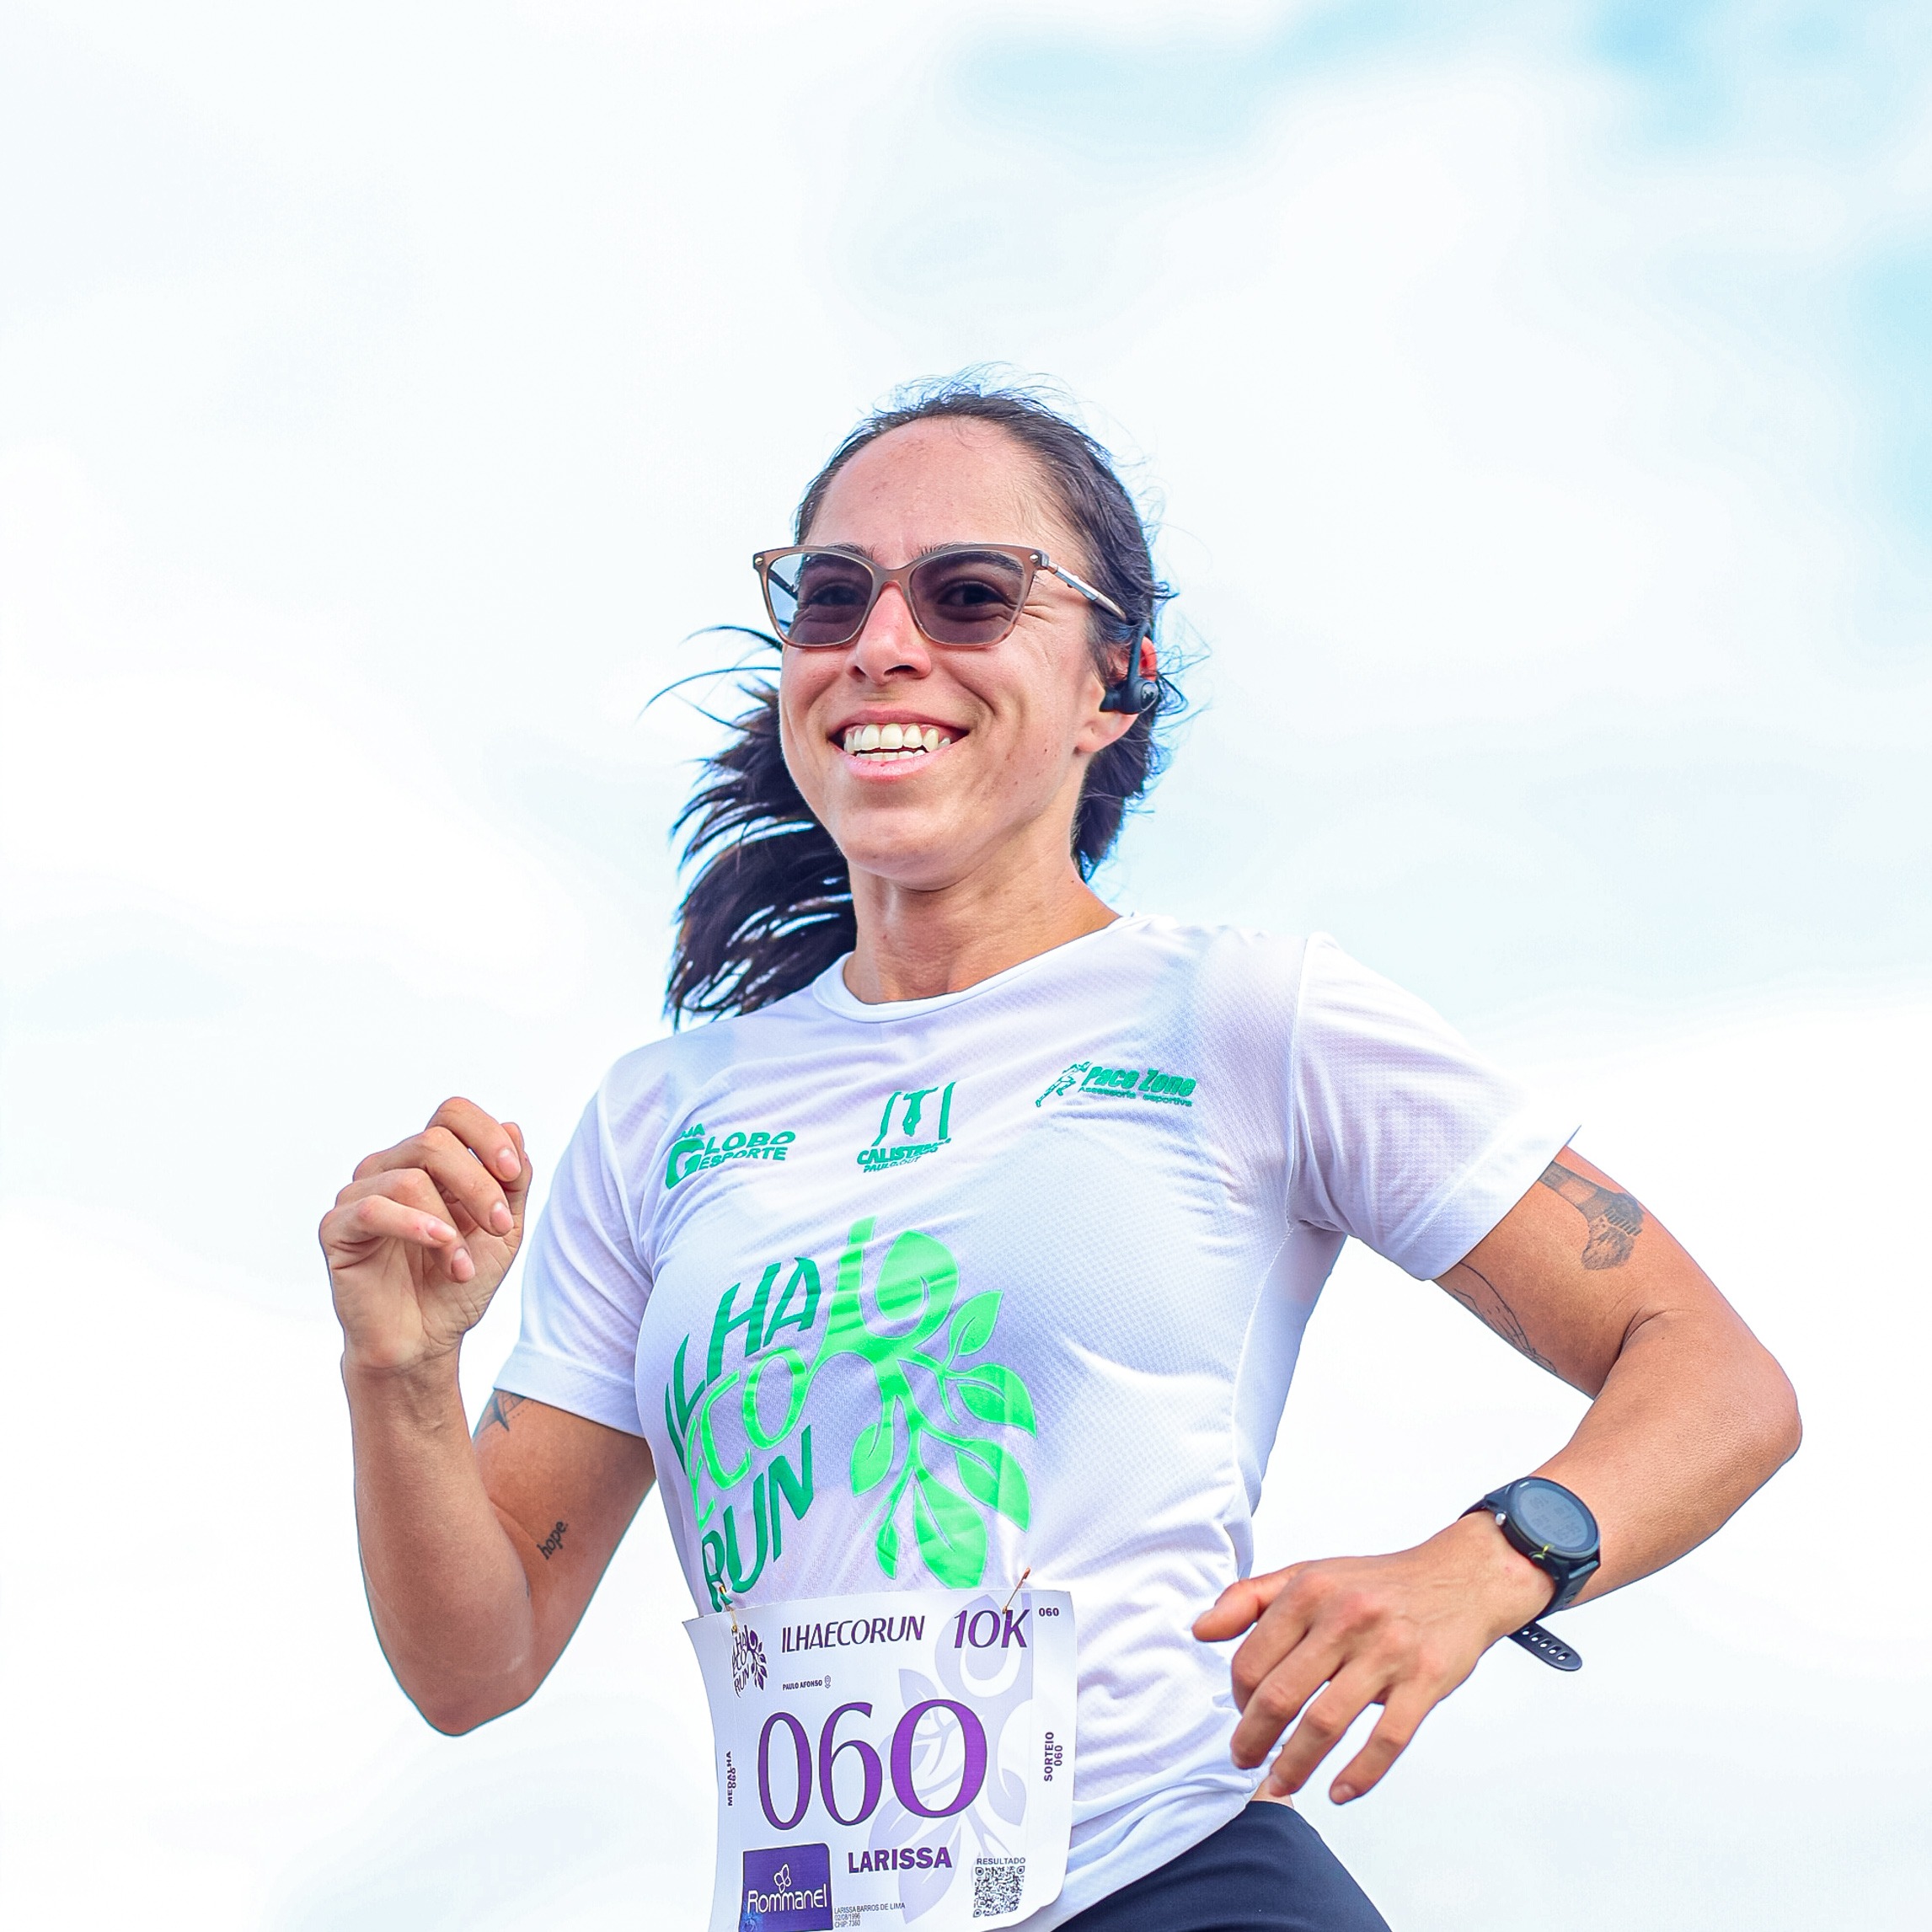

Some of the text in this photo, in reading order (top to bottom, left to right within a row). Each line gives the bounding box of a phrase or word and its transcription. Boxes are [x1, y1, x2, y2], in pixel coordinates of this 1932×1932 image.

[1081, 1066, 1197, 1097] Pace Zone
[698, 1147, 789, 1171] ESPORTE
[665, 1256, 822, 1475] ILHA
[686, 1346, 809, 1532] ECO
[701, 1424, 814, 1613] RUN
[536, 1521, 569, 1560] hope
[953, 1608, 1031, 1649] 10K
[1038, 1607, 1060, 1617] 060
[781, 1615, 926, 1654] ILHAECORUN
[734, 1663, 750, 1699] RUN
[782, 1679, 823, 1691] PAULO AFONSO
[757, 1699, 988, 1831] 060
[1044, 1731, 1054, 1782] SORTEIO
[1053, 1745, 1063, 1767] 060
[848, 1846, 953, 1874] LARISSA
[976, 1856, 1026, 1865] RESULTADO
[747, 1883, 827, 1914] Rommanel
[834, 1902, 906, 1914] LARISSA BARROS DE LIMA
